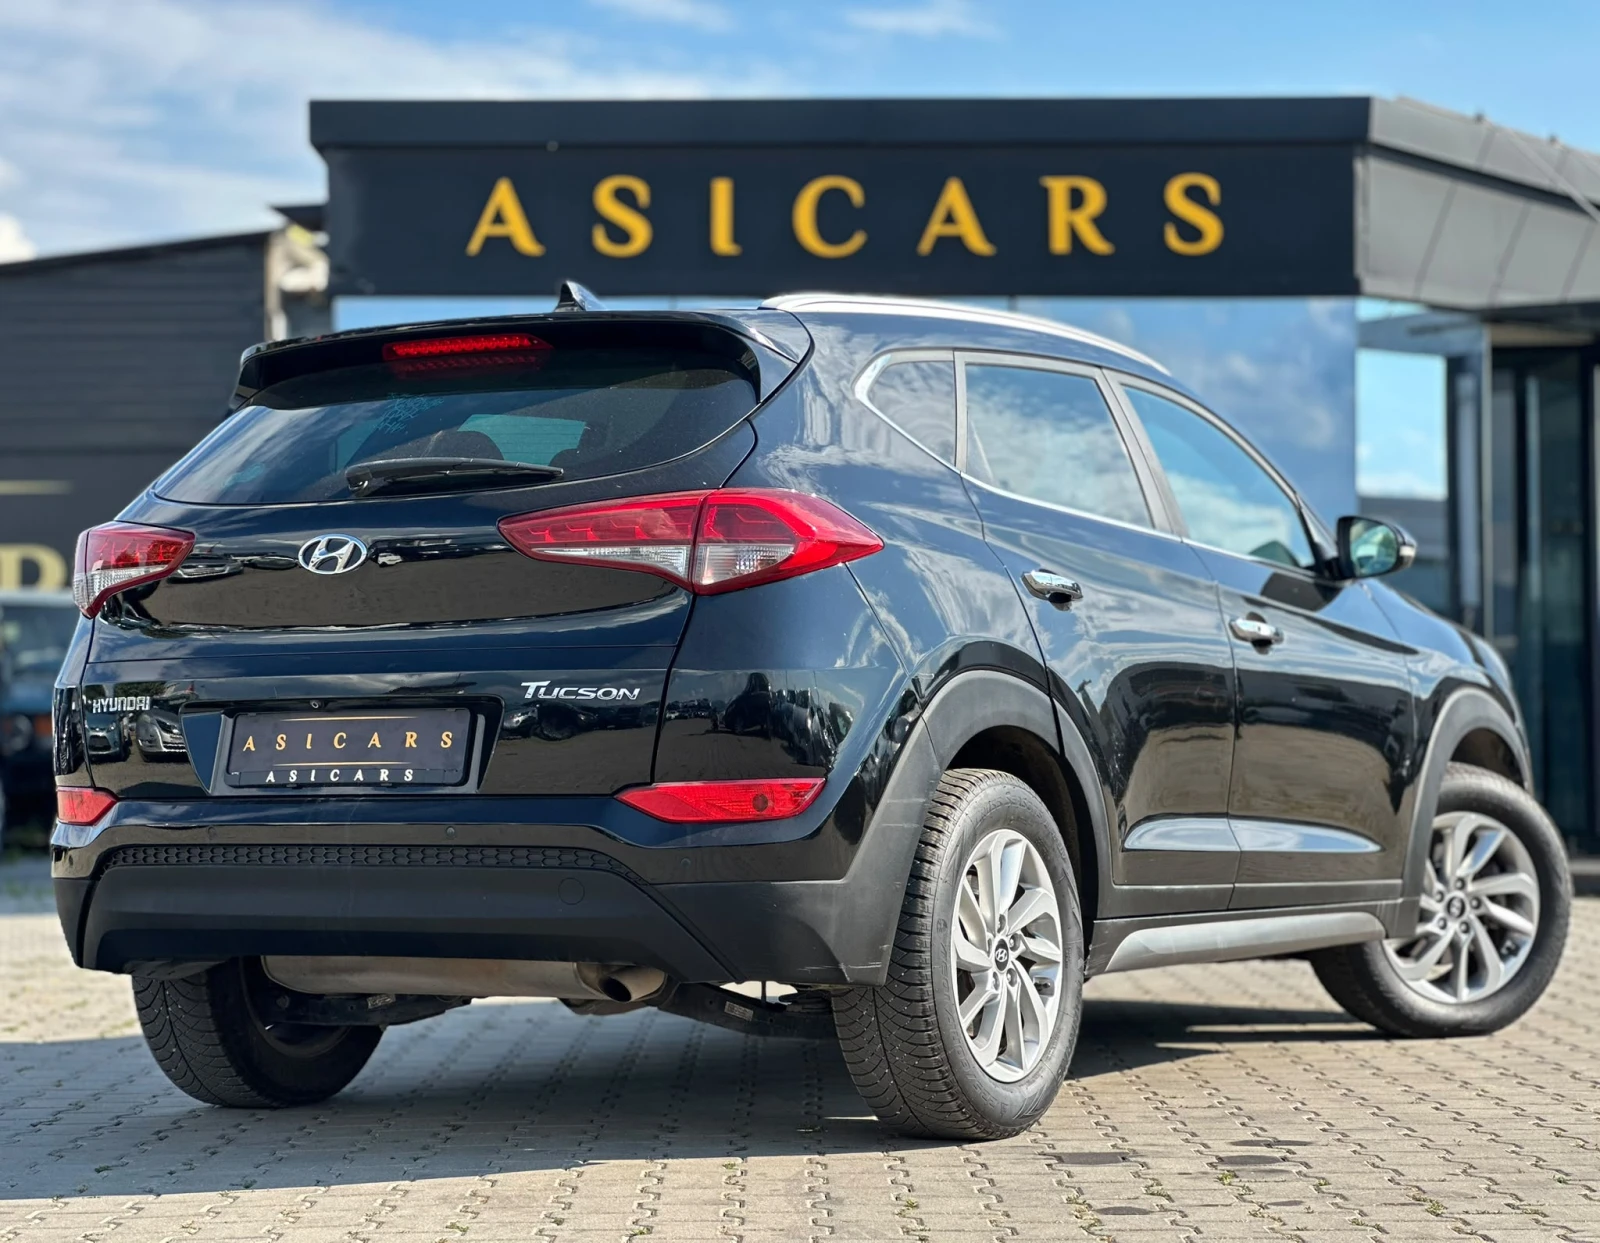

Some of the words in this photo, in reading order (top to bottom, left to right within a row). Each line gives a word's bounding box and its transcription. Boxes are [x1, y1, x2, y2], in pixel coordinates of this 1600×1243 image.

[466, 172, 1224, 259] ASICARS
[520, 680, 641, 701] TUCSON
[92, 696, 151, 714] HYUNDAI
[243, 731, 453, 752] ASICARS
[265, 769, 414, 783] ASICARS
